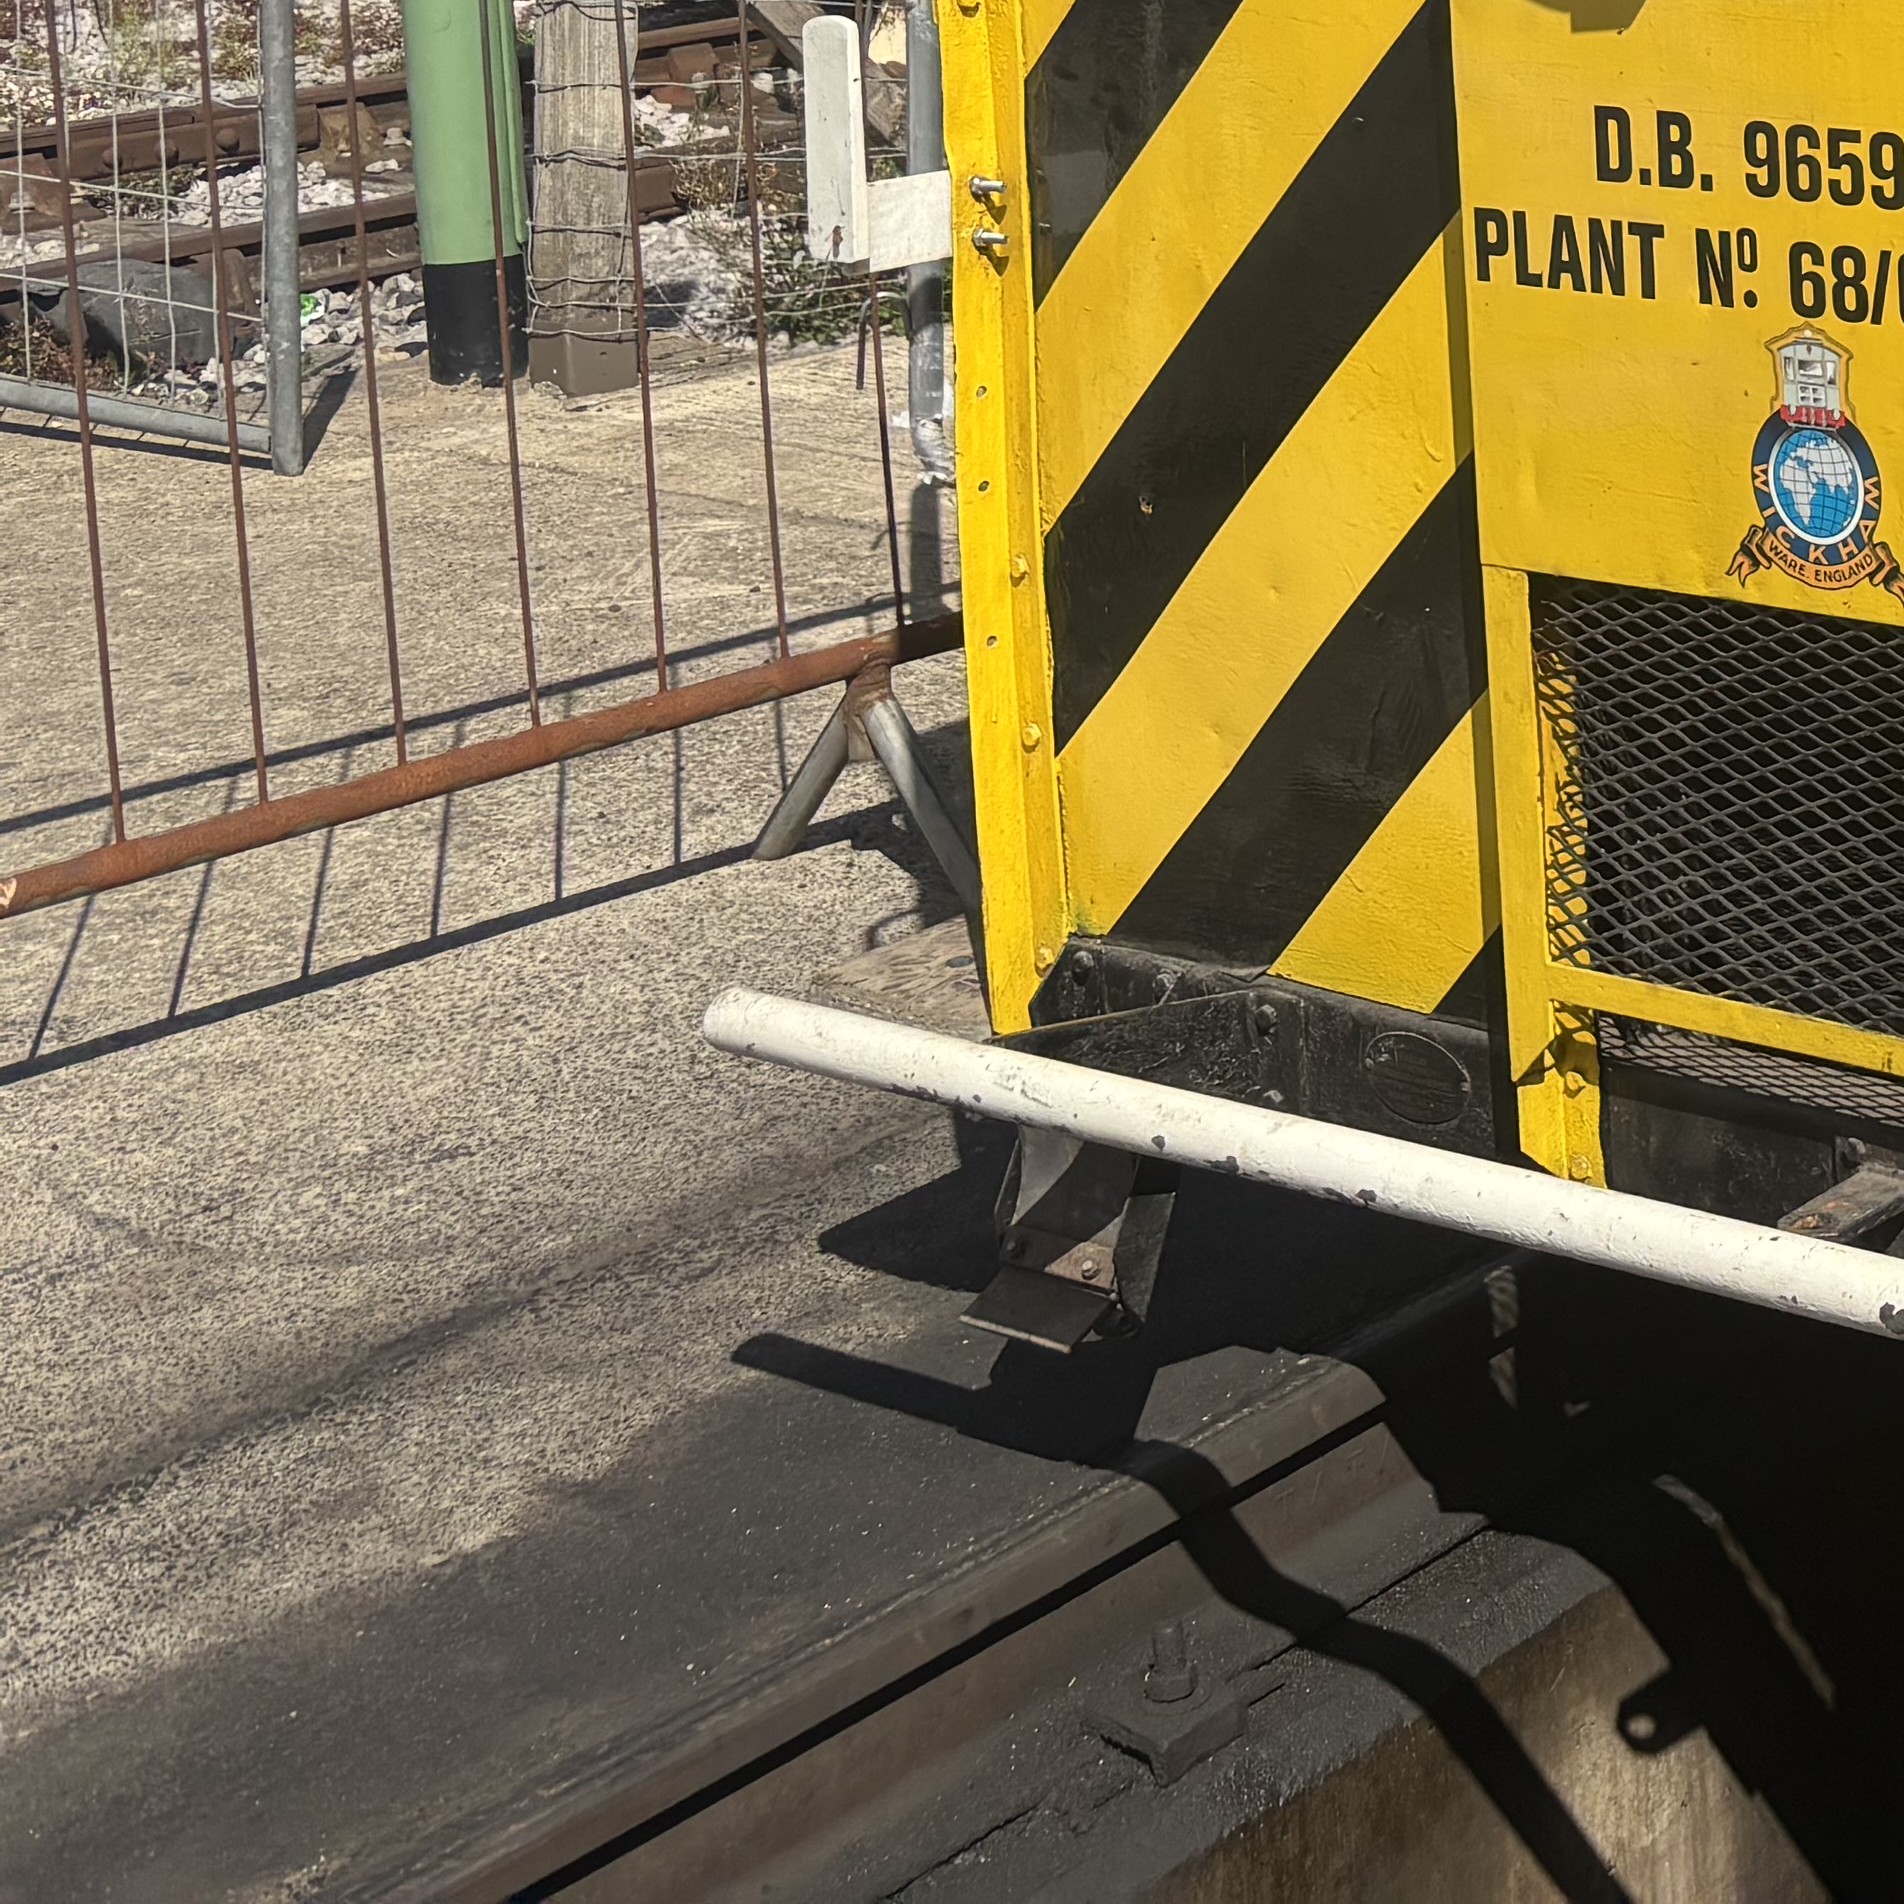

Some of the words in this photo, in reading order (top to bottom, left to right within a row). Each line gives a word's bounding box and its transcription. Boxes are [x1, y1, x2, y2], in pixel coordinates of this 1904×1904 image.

[1594, 104, 1714, 192] D.B.
[1473, 206, 1665, 300] PLANT
[1753, 463, 1880, 566] WICKHAM
[1814, 552, 1874, 584] ENGLAND
